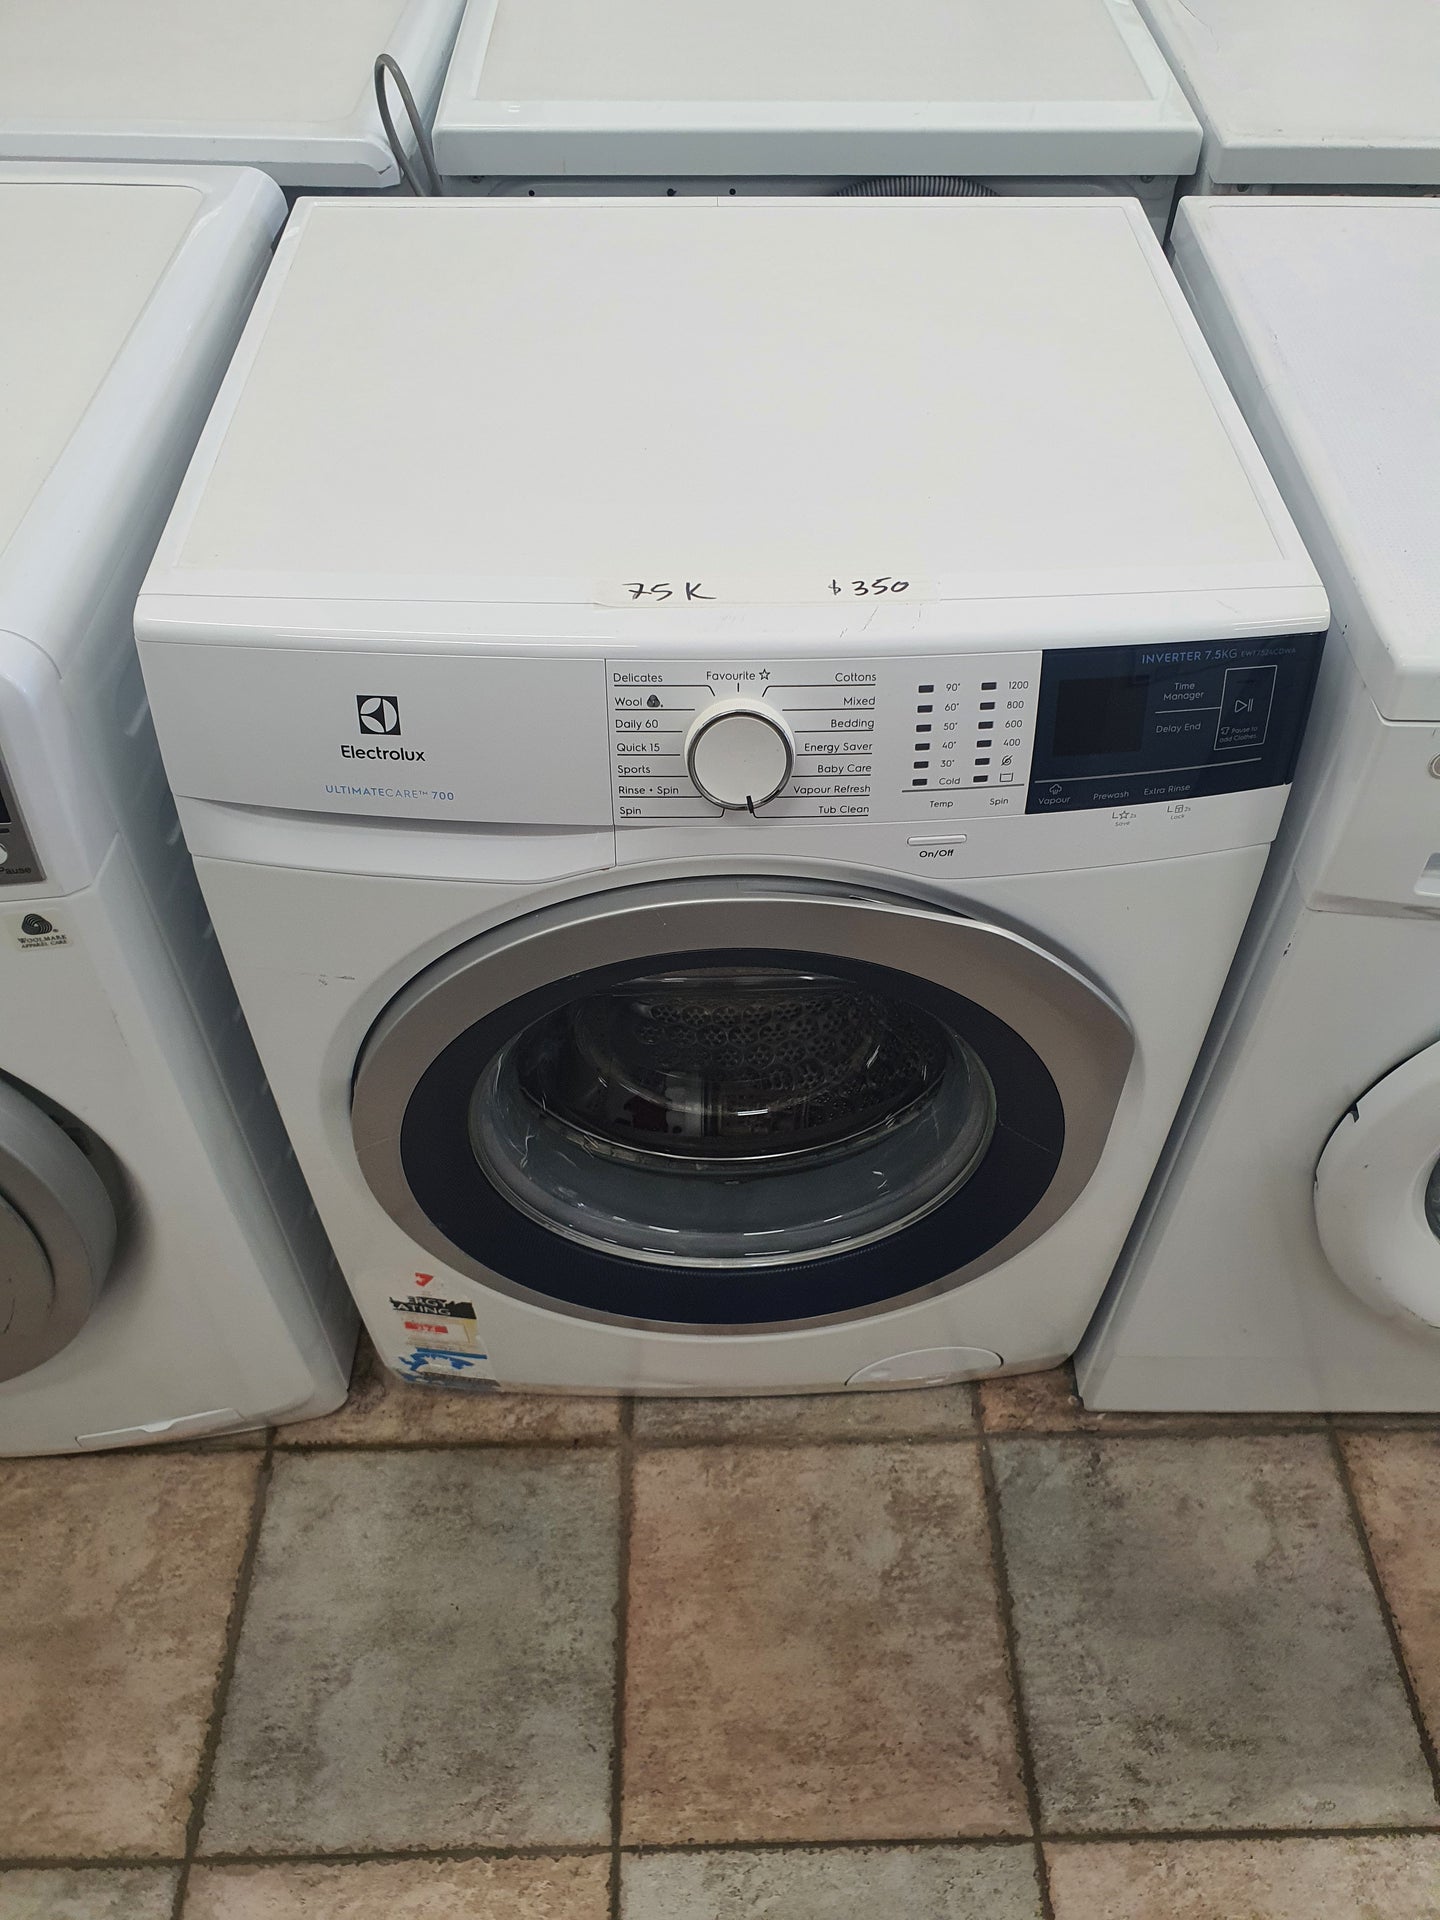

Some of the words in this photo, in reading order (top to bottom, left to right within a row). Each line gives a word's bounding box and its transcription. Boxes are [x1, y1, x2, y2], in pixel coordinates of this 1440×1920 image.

[1141, 651, 1201, 665] INVERTER
[1204, 649, 1238, 661] 7.5KG
[613, 672, 663, 683] Delicates
[706, 671, 756, 681] Favourite
[835, 672, 877, 683] Cottons
[1008, 681, 1029, 690] 1200
[1175, 681, 1195, 690] Time
[1163, 690, 1204, 701] Manager
[615, 697, 643, 707] Wool
[843, 696, 876, 706] Mixed
[1006, 701, 1025, 709] 800
[615, 719, 643, 730] Daily
[645, 719, 658, 729] 60
[831, 719, 875, 730] Bedding
[1005, 720, 1023, 728] 600
[1156, 724, 1182, 734] Delay
[1184, 722, 1201, 731] End
[617, 743, 647, 753] Quick
[650, 743, 660, 752] 15
[804, 743, 840, 754] Energy
[843, 742, 873, 751] Saver
[1003, 739, 1021, 747] 400
[340, 745, 426, 762] Electrolux
[617, 765, 651, 775] Sports
[817, 764, 845, 775] Baby
[847, 764, 872, 773] Care
[939, 777, 961, 785] Cold
[618, 785, 648, 795] Rinse
[657, 785, 679, 796] Spin
[793, 785, 832, 795] Vapour
[834, 784, 871, 794] Refresh
[1143, 786, 1166, 796] Extra
[1168, 783, 1191, 793] Rinse
[431, 791, 454, 801] 700
[1093, 790, 1130, 801] Prewash
[929, 800, 954, 809] Temp
[989, 797, 1009, 806] Spin
[1038, 796, 1071, 806] Vapour
[619, 806, 642, 817] Spin
[818, 805, 837, 815] Tub
[840, 804, 869, 814] Clean
[919, 850, 954, 859] On/Off
[17, 934, 67, 944] WOOLMARK
[393, 1303, 451, 1316] ATING
